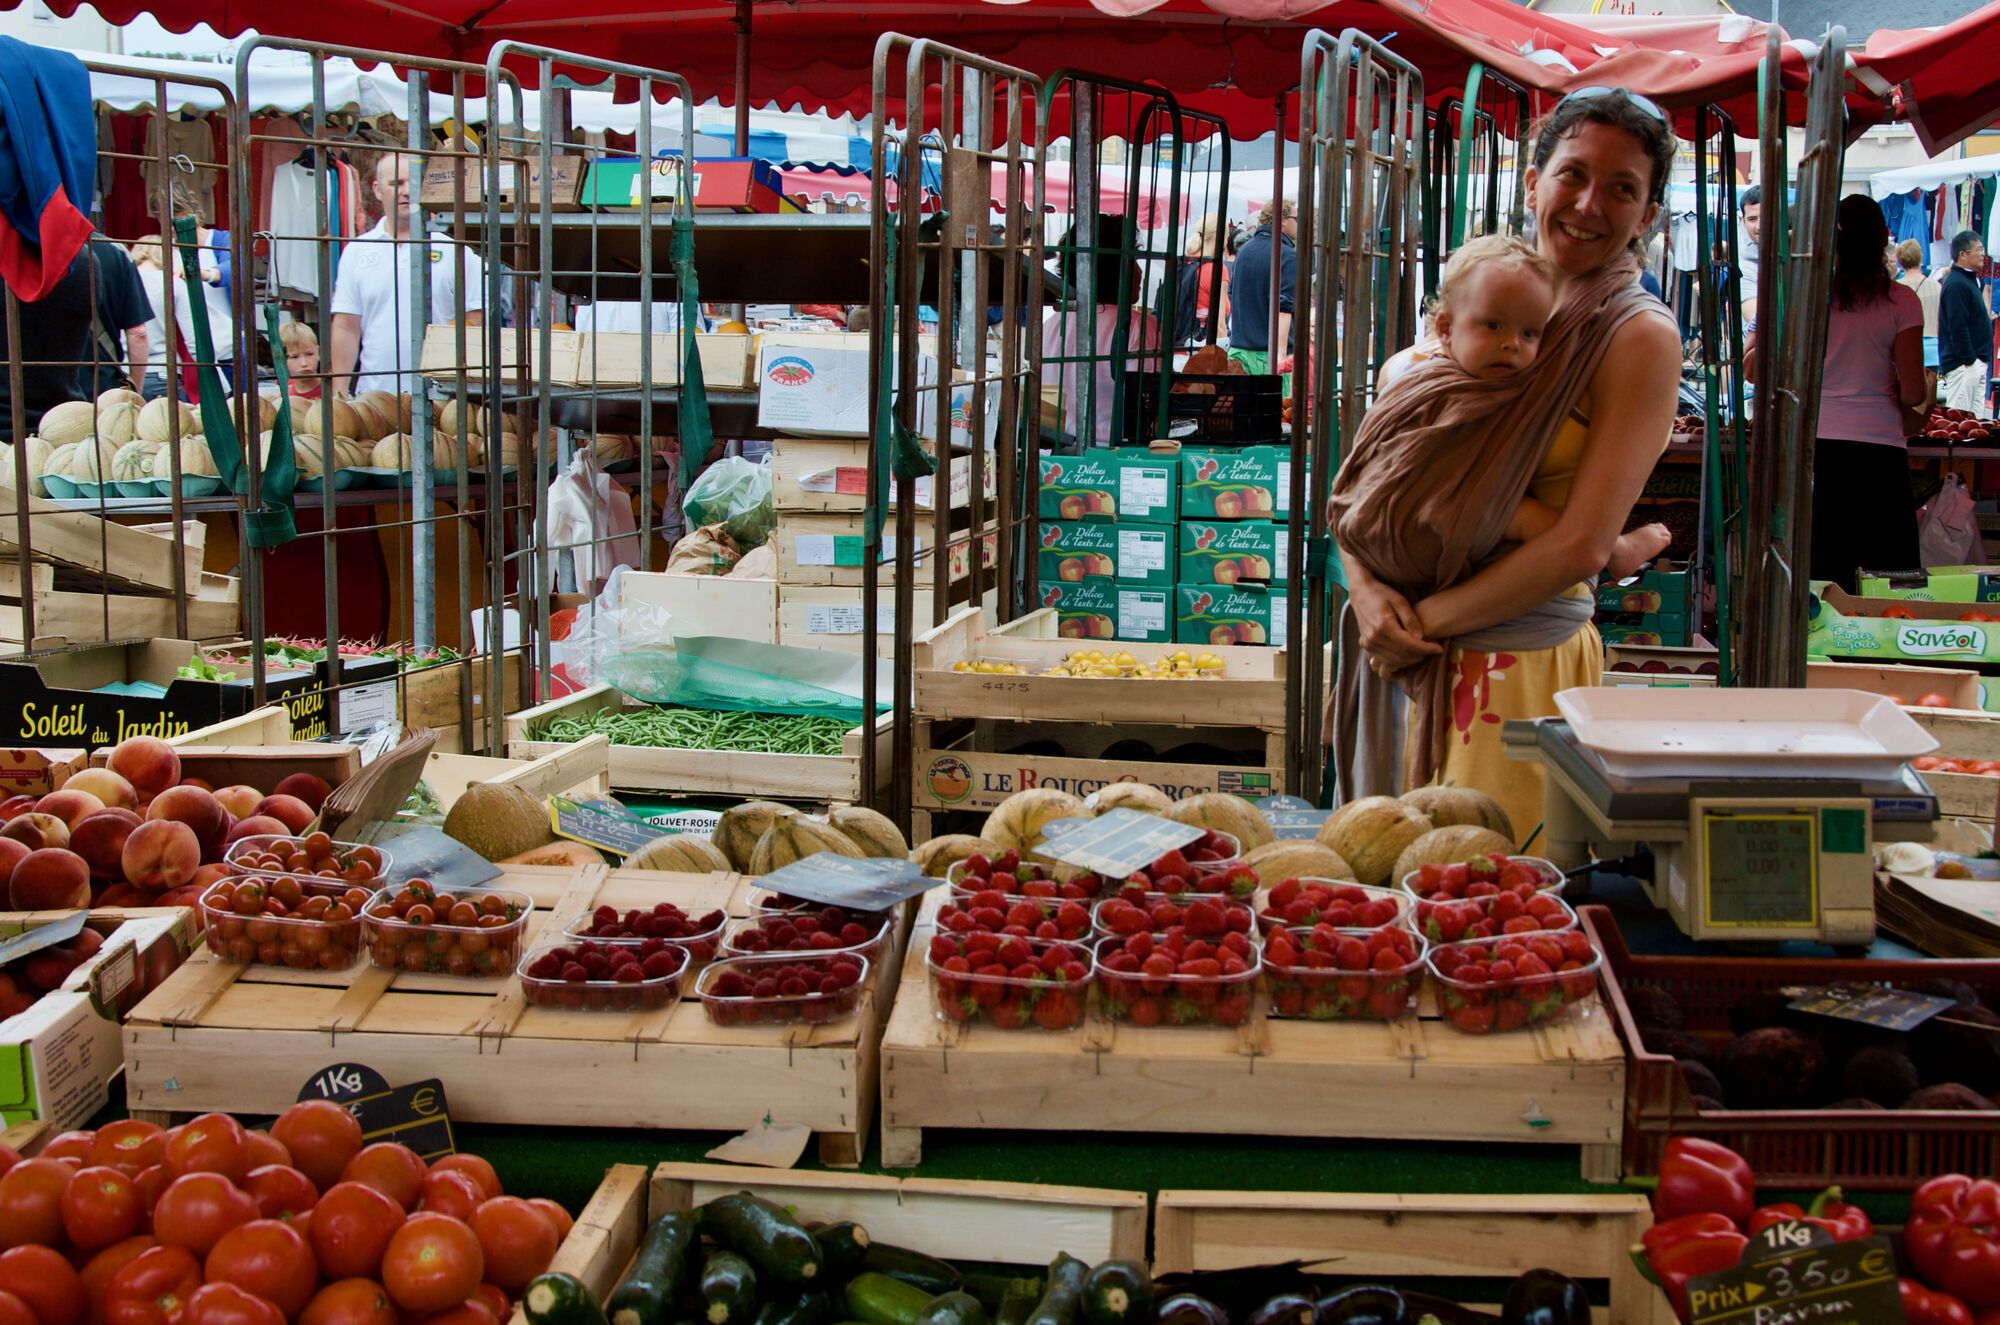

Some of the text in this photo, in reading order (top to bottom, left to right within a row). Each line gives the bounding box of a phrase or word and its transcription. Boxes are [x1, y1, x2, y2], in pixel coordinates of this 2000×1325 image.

[771, 374, 811, 387] FRANCE
[1077, 461, 1106, 475] Délices
[1233, 457, 1263, 470] Délices
[1061, 470, 1115, 485] de Tante Line
[1216, 466, 1273, 481] de Tante Line
[1076, 525, 1104, 538] Délices
[1231, 526, 1261, 539] Délices
[1060, 533, 1114, 548] de Tante Line
[1215, 535, 1271, 550] de Tante Line
[1076, 586, 1104, 599] Délices
[1228, 592, 1257, 604] Délices
[1060, 594, 1115, 609] de Tante Line
[1211, 600, 1267, 615] de Tante Line
[1902, 629, 1977, 649] Savéol
[20, 702, 189, 745] Soleil du Jardin
[983, 772, 1013, 793] LE
[1746, 859, 1780, 874] 0.00
[315, 1066, 364, 1098] 1Kg
[410, 1088, 440, 1115] €
[1764, 1220, 1811, 1248] 1Kg
[1690, 1284, 1743, 1315] Prix
[1859, 1249, 1891, 1276] €
